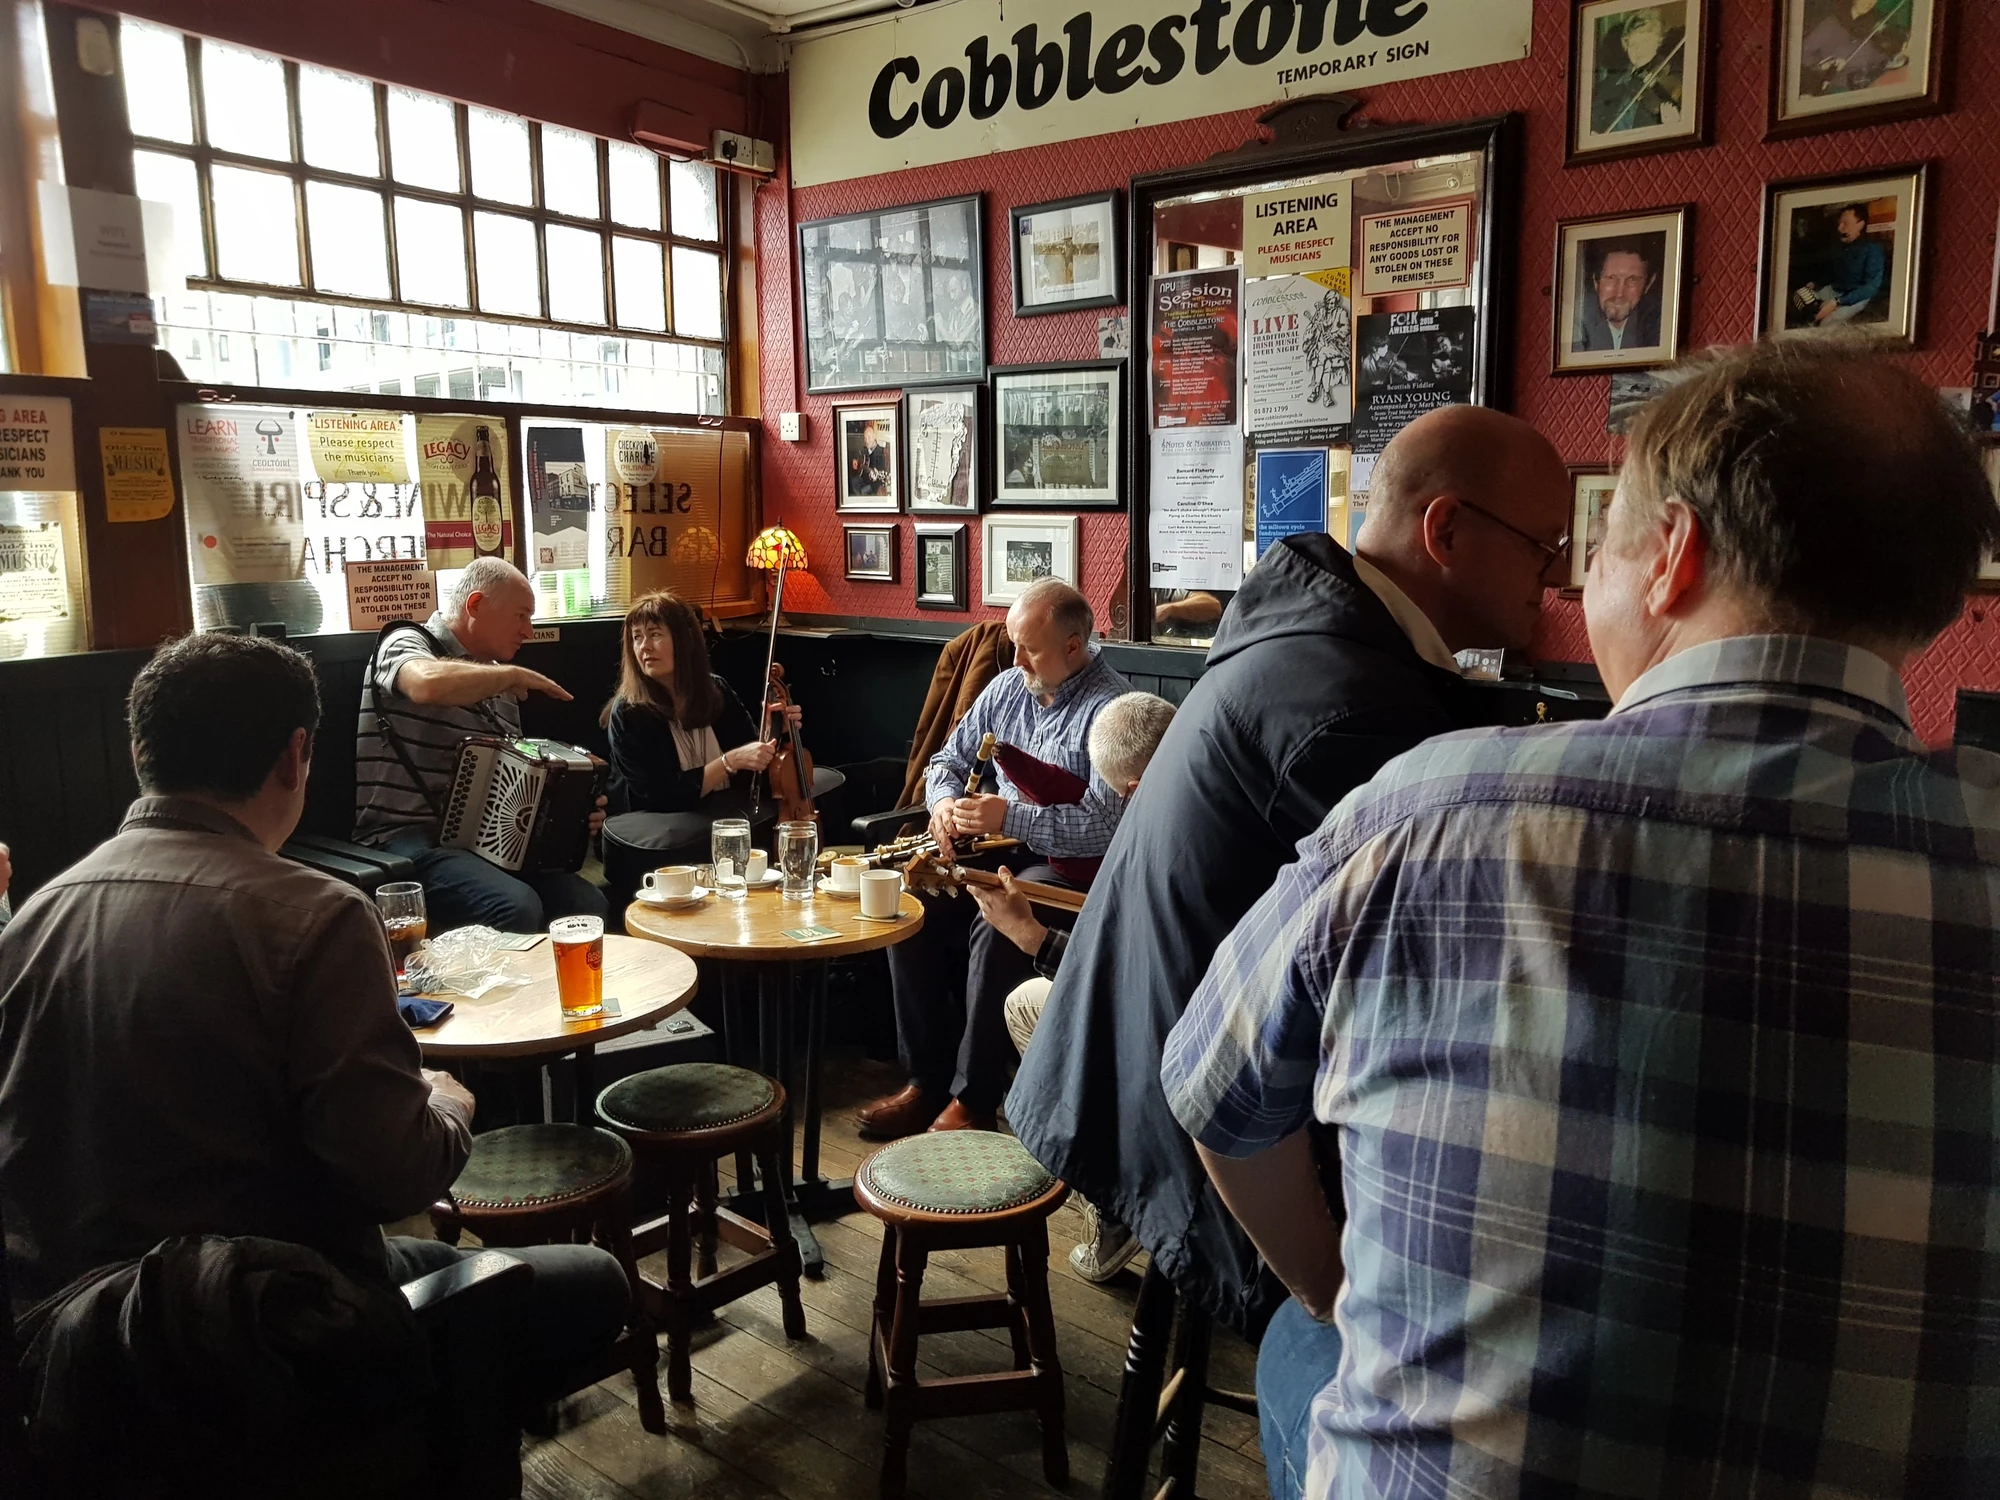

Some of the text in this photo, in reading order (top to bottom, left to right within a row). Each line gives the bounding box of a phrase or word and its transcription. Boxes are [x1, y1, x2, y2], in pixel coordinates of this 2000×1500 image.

[868, 0, 1428, 139] Cobblestone
[1277, 41, 1429, 85] TEMPORARY SIGN
[1256, 193, 1338, 218] LISTENING
[1375, 210, 1455, 229] THE MANAGEMENT
[1273, 217, 1318, 237] AREA
[1389, 224, 1438, 239] ACCEPT NO
[1258, 237, 1335, 255] PLEASE RESPECT
[1369, 233, 1460, 253] RESPONSIBILITY FOR
[1269, 251, 1321, 265] MUSICIANS
[1369, 245, 1459, 264] ANY GOODS LOST OR
[1374, 257, 1454, 275] STOLEN ON THESE
[1326, 273, 1347, 286] COVER
[1392, 271, 1435, 284] PREMISES
[1319, 277, 1347, 294] CHARGE
[1158, 283, 1233, 312] Session
[1180, 301, 1199, 311] The
[1252, 313, 1300, 336] LIVE
[1390, 311, 1419, 328] FOLK
[1252, 331, 1300, 344] TRADITIONAL
[1252, 338, 1300, 351] IRISH MUSIC
[1252, 345, 1300, 357] EVERY NIGHT
[1412, 381, 1435, 389] Fiddler
[1372, 391, 1451, 405] RYAN YOUNG
[1273, 405, 1289, 413] 1799
[1368, 403, 1408, 412] Accompanied
[1409, 402, 1417, 410] by
[13, 409, 48, 425] AREA
[187, 418, 239, 437] LEARN
[315, 418, 397, 432] LISTENING AREA
[320, 436, 395, 450] Please respect
[1165, 441, 1185, 450] NOTES
[1186, 440, 1193, 448] &
[1194, 440, 1231, 449] NARRATIVES
[324, 452, 395, 464] the musicians
[423, 441, 471, 461] LEGACY
[619, 450, 655, 464] CHARLIE
[113, 455, 157, 471] MUSIC
[252, 458, 291, 468] CEOLTÓIRÍ
[25, 467, 45, 479] YOU
[475, 524, 500, 536] LEGACY
[0, 551, 50, 570] MUSIC
[357, 563, 425, 575] THE MANAGEMENT
[371, 573, 413, 584] ACCEPT NO
[354, 582, 431, 595] RESPONSIBILITY FOR
[355, 592, 431, 605] ANY GOODS LOST OR
[360, 604, 390, 614] STOLEN
[404, 602, 427, 610] THESE
[377, 613, 413, 623] PREMISES
[533, 630, 556, 640] CIANS
